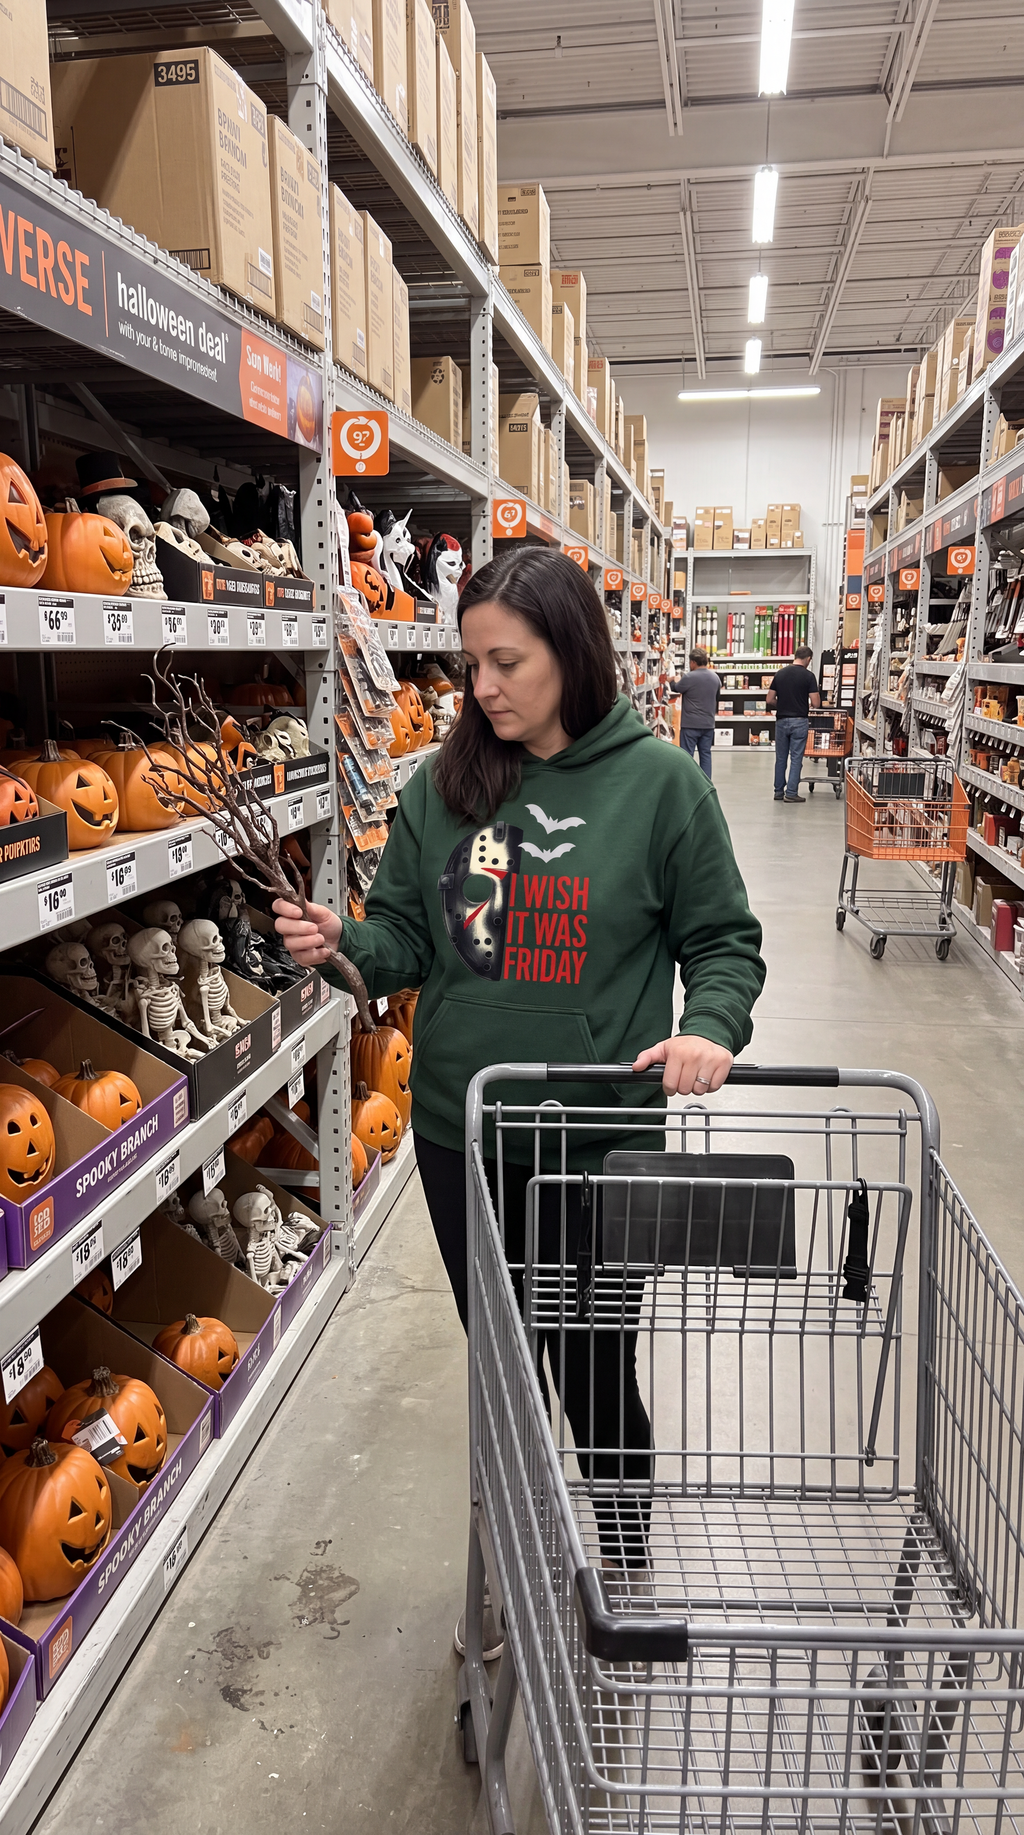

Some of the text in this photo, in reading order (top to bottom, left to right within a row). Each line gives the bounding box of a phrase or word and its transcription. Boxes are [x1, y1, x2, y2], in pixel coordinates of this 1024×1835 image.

[158, 63, 196, 83] 3495
[0, 203, 93, 317] VERSE
[117, 271, 195, 348] halloween
[118, 320, 135, 341] with
[136, 330, 152, 346] your
[152, 336, 159, 352] &
[353, 431, 370, 444] 97
[509, 873, 589, 910] I WISH
[506, 911, 588, 948] IT WAS
[503, 946, 588, 984] FRIDAY
[76, 1148, 119, 1198] SPOOKY
[120, 1114, 159, 1161] BRANCH
[98, 1517, 142, 1595] SPOOKY
[143, 1457, 183, 1526] BRANCH
